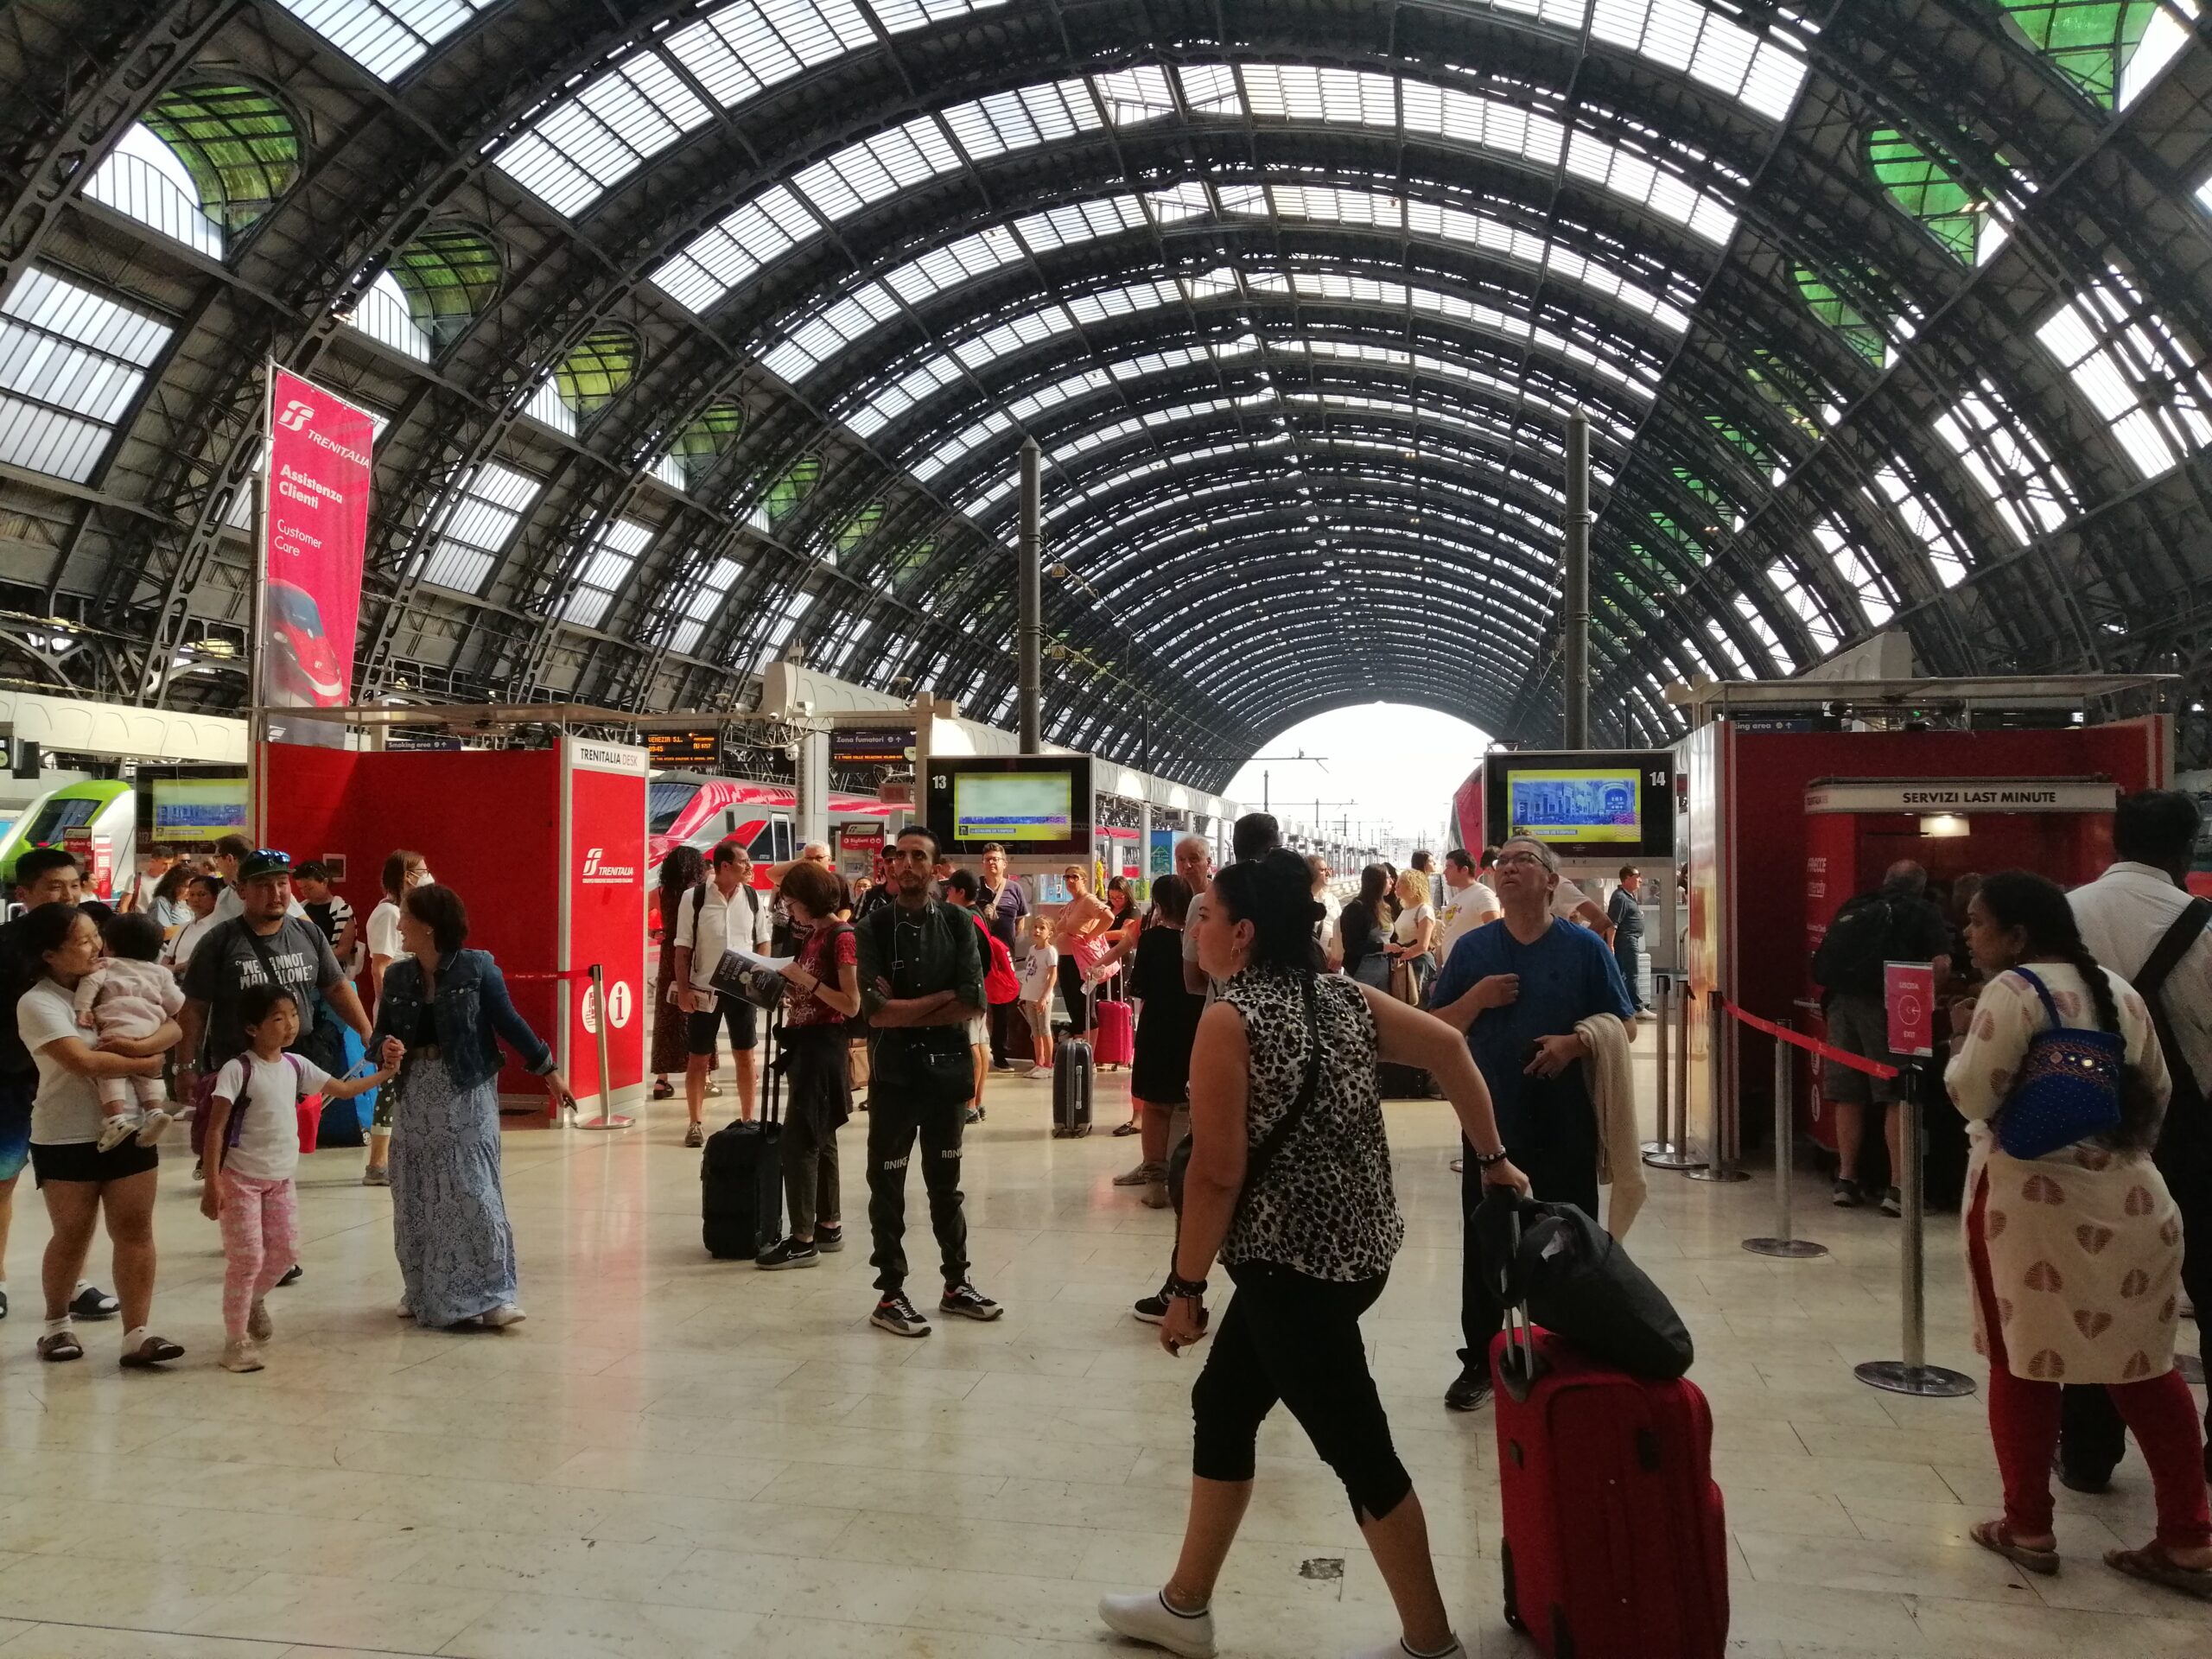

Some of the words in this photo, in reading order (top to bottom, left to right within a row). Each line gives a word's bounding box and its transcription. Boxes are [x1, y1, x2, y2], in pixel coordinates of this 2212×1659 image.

[308, 429, 371, 469] TRENITALIA
[280, 463, 343, 504] Assistenza
[279, 481, 319, 510] Clienti
[276, 518, 322, 550] Customer
[274, 535, 300, 556] Care
[581, 747, 621, 765] TRENITALIA
[622, 753, 638, 767] DESK
[932, 775, 947, 789] 13
[1649, 771, 1666, 786] 14
[1903, 791, 1959, 804] SERVIZI
[1964, 791, 1997, 803] LAST
[2000, 791, 2056, 803] MINUTE
[599, 866, 633, 876] TRENITALIA
[269, 952, 304, 971] ANNOT
